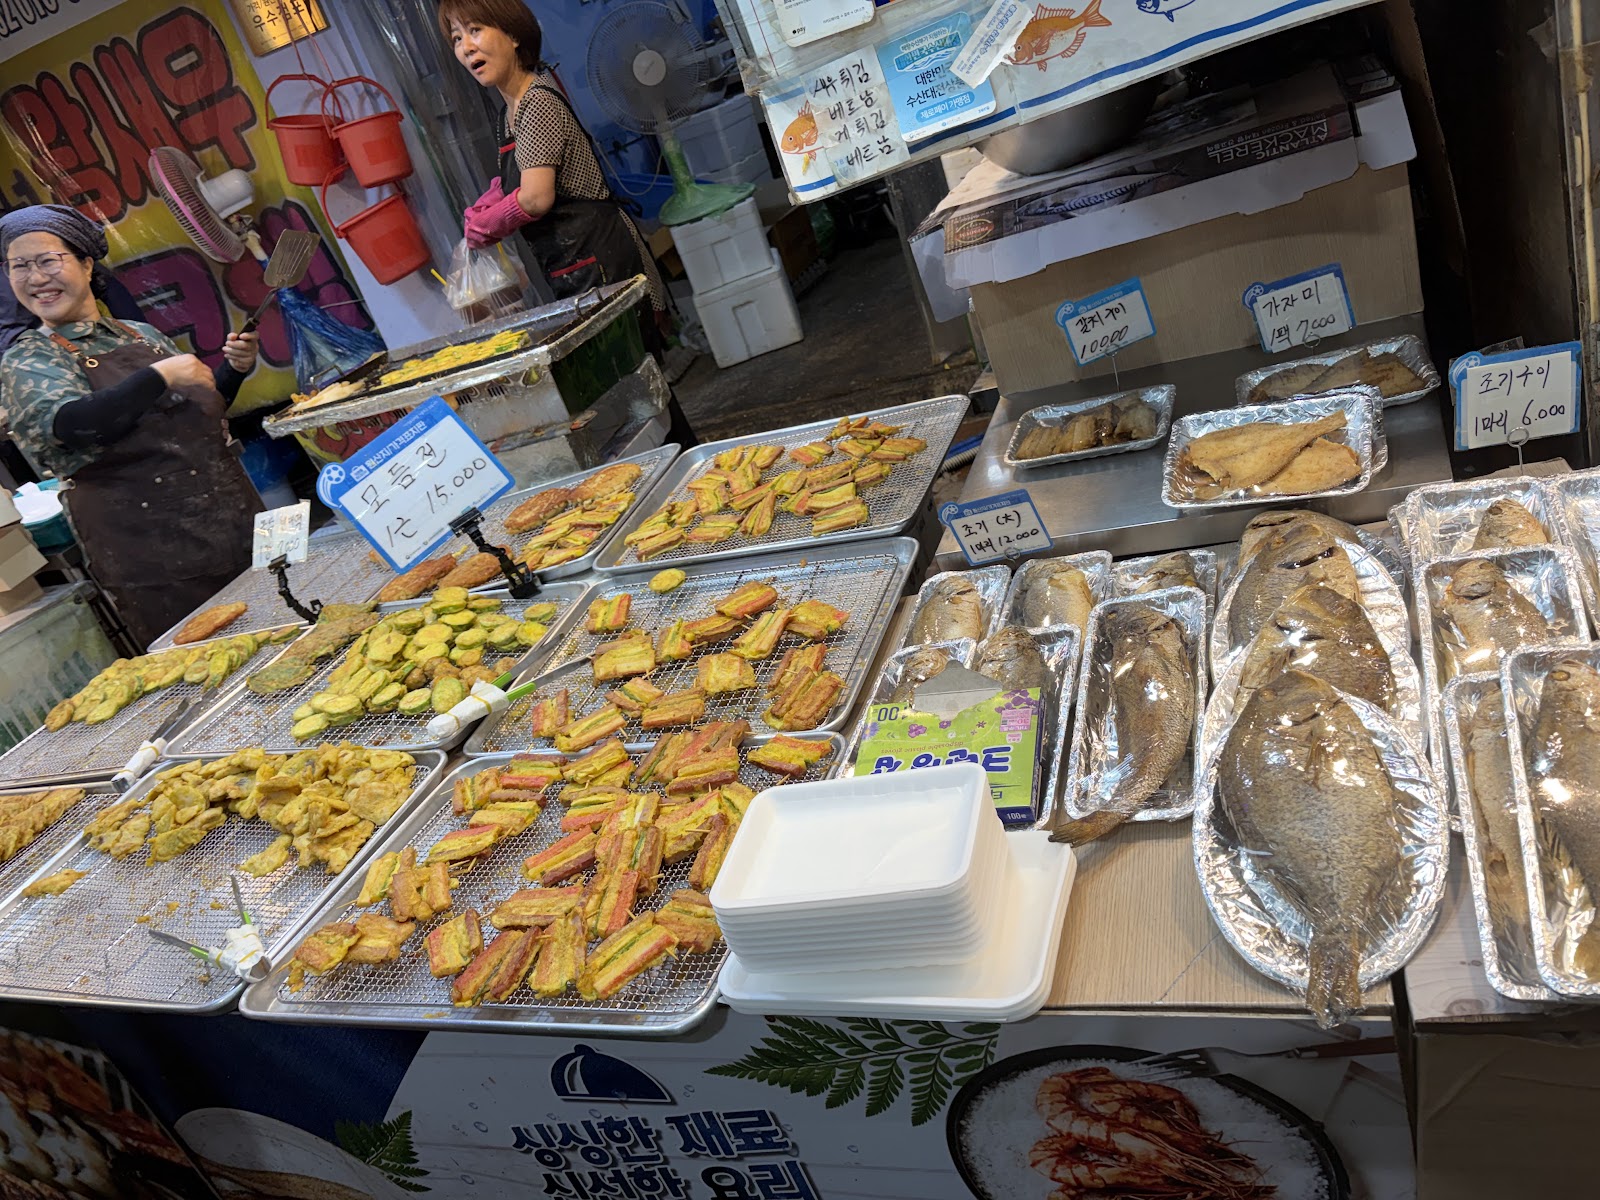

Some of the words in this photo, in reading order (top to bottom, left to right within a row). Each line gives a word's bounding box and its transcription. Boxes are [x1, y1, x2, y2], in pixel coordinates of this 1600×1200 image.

[827, 90, 878, 120] 베트남
[846, 135, 896, 169] 베트남
[1215, 122, 1328, 164] MACKEREL
[1256, 133, 1328, 160] ATLANTIC
[1263, 280, 1321, 318] 가자미
[1522, 399, 1566, 426] 6.000
[426, 457, 487, 514] 15.000
[961, 519, 989, 538] 조기
[998, 528, 1040, 547] 12.000
[928, 741, 964, 751] disposable
[511, 1115, 662, 1168] 싱싱한
[664, 1109, 789, 1157] 재료
